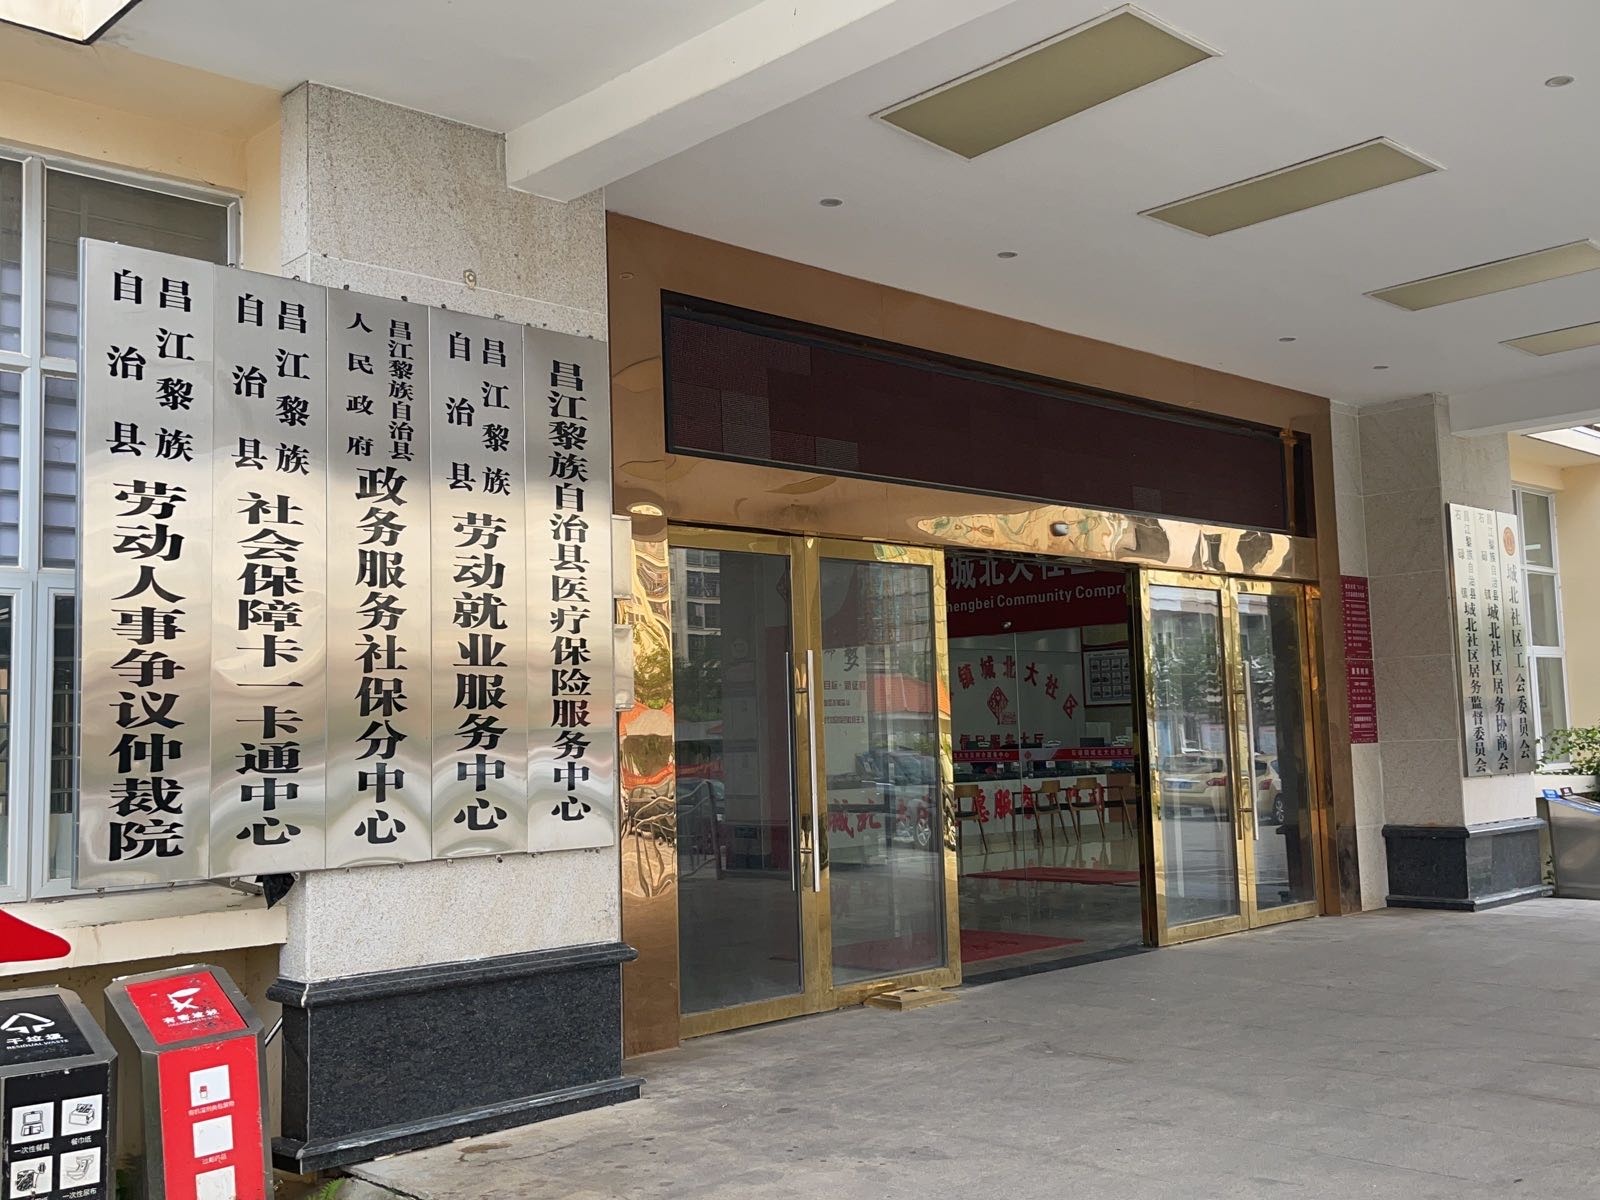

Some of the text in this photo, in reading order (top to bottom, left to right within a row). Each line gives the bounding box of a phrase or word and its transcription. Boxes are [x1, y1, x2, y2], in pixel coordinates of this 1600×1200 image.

[106, 268, 146, 457] 自治县
[155, 276, 195, 463] 昌江黎族
[231, 293, 268, 471] 自治县
[275, 300, 311, 476] 昌江黎族
[346, 312, 375, 457] 人民政府
[386, 319, 415, 462] 昌江黎族自治县
[445, 331, 477, 493] 自治县
[481, 337, 512, 497] 昌江黎族
[108, 479, 187, 862] 劳动人事争议仲裁院
[235, 490, 304, 846] 社会保障卡一卡通中心
[354, 466, 408, 845] 政务服务社保分中心
[451, 511, 508, 832] 劳动就业服务中心
[548, 359, 592, 822] 昌江黎族自治县医疗保险服务中心
[997, 588, 1073, 607] Community
[1506, 563, 1530, 759] 城北社区工会委员会
[1464, 601, 1488, 773] 城北社区居务监督委员会
[1486, 603, 1510, 770] 城北社区居务协商会
